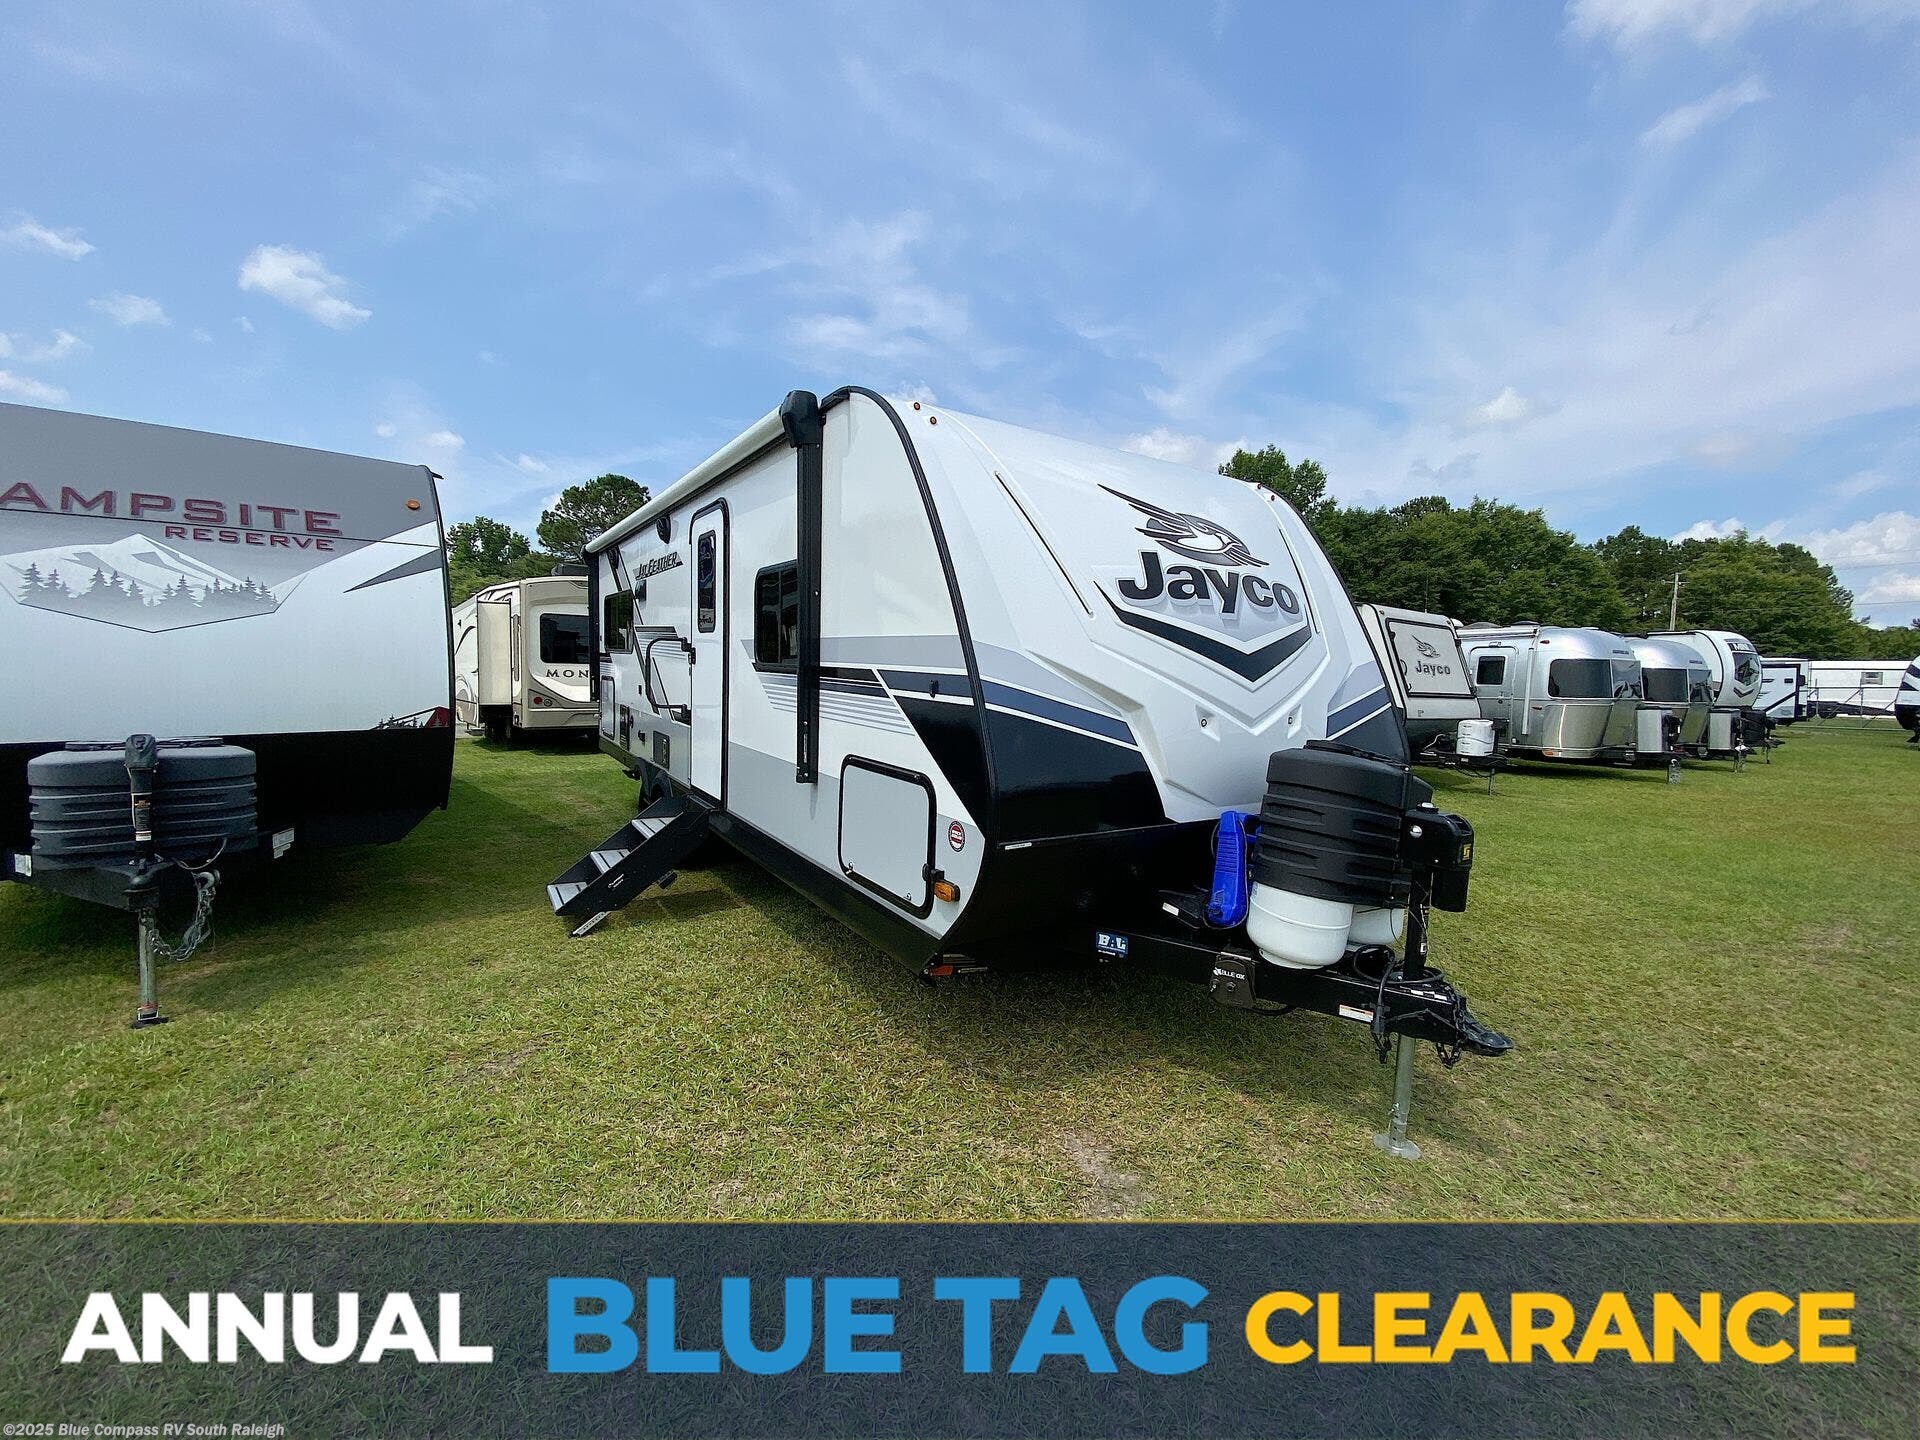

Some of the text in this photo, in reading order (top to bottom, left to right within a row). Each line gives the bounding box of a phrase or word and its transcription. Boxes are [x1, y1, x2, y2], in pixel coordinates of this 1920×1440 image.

[164, 525, 335, 552] RESERVE
[1117, 549, 1301, 619] Jayco
[545, 668, 590, 679] MON
[1415, 659, 1451, 677] Jayco
